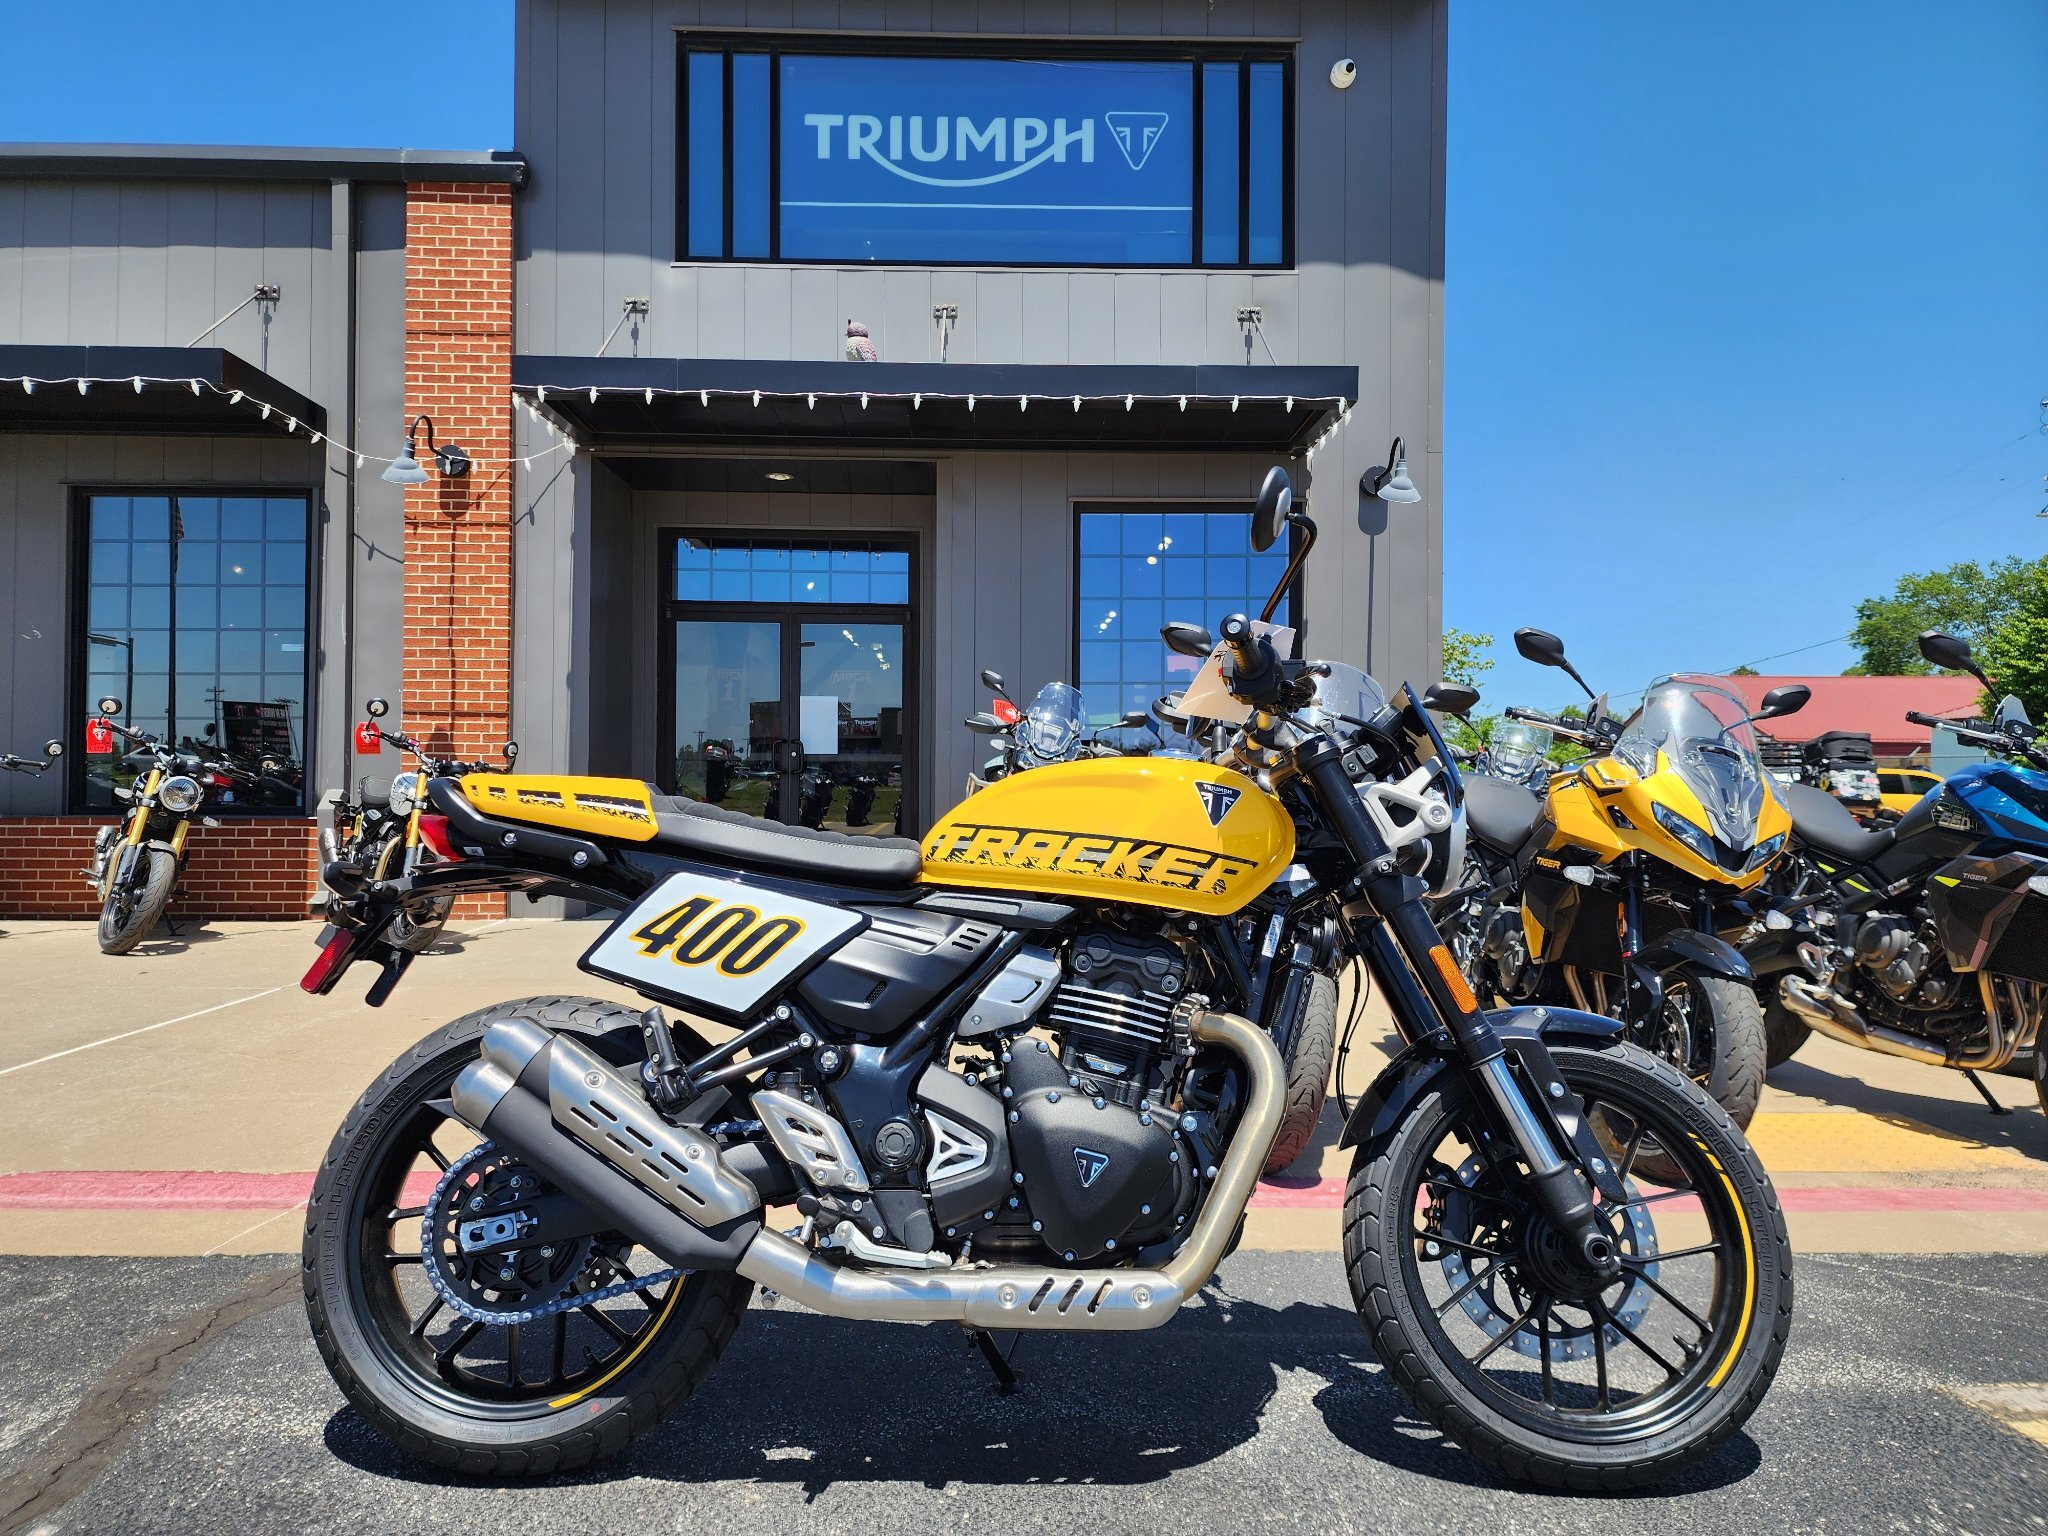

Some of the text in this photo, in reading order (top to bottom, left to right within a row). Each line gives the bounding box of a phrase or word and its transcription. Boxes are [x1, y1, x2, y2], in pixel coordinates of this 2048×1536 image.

[804, 114, 1095, 187] TRIUMPH
[1203, 784, 1233, 795] TRIUMPH
[926, 823, 1258, 896] TRACKER
[1536, 856, 1561, 870] TIGER
[1962, 872, 1988, 882] TIGER
[628, 894, 806, 978] 400
[1683, 1106, 1754, 1195] PIRELLI
[319, 1190, 342, 1306] PIRELLI
[381, 1081, 411, 1114] RS
[1401, 1303, 1467, 1401] PIRELLI
